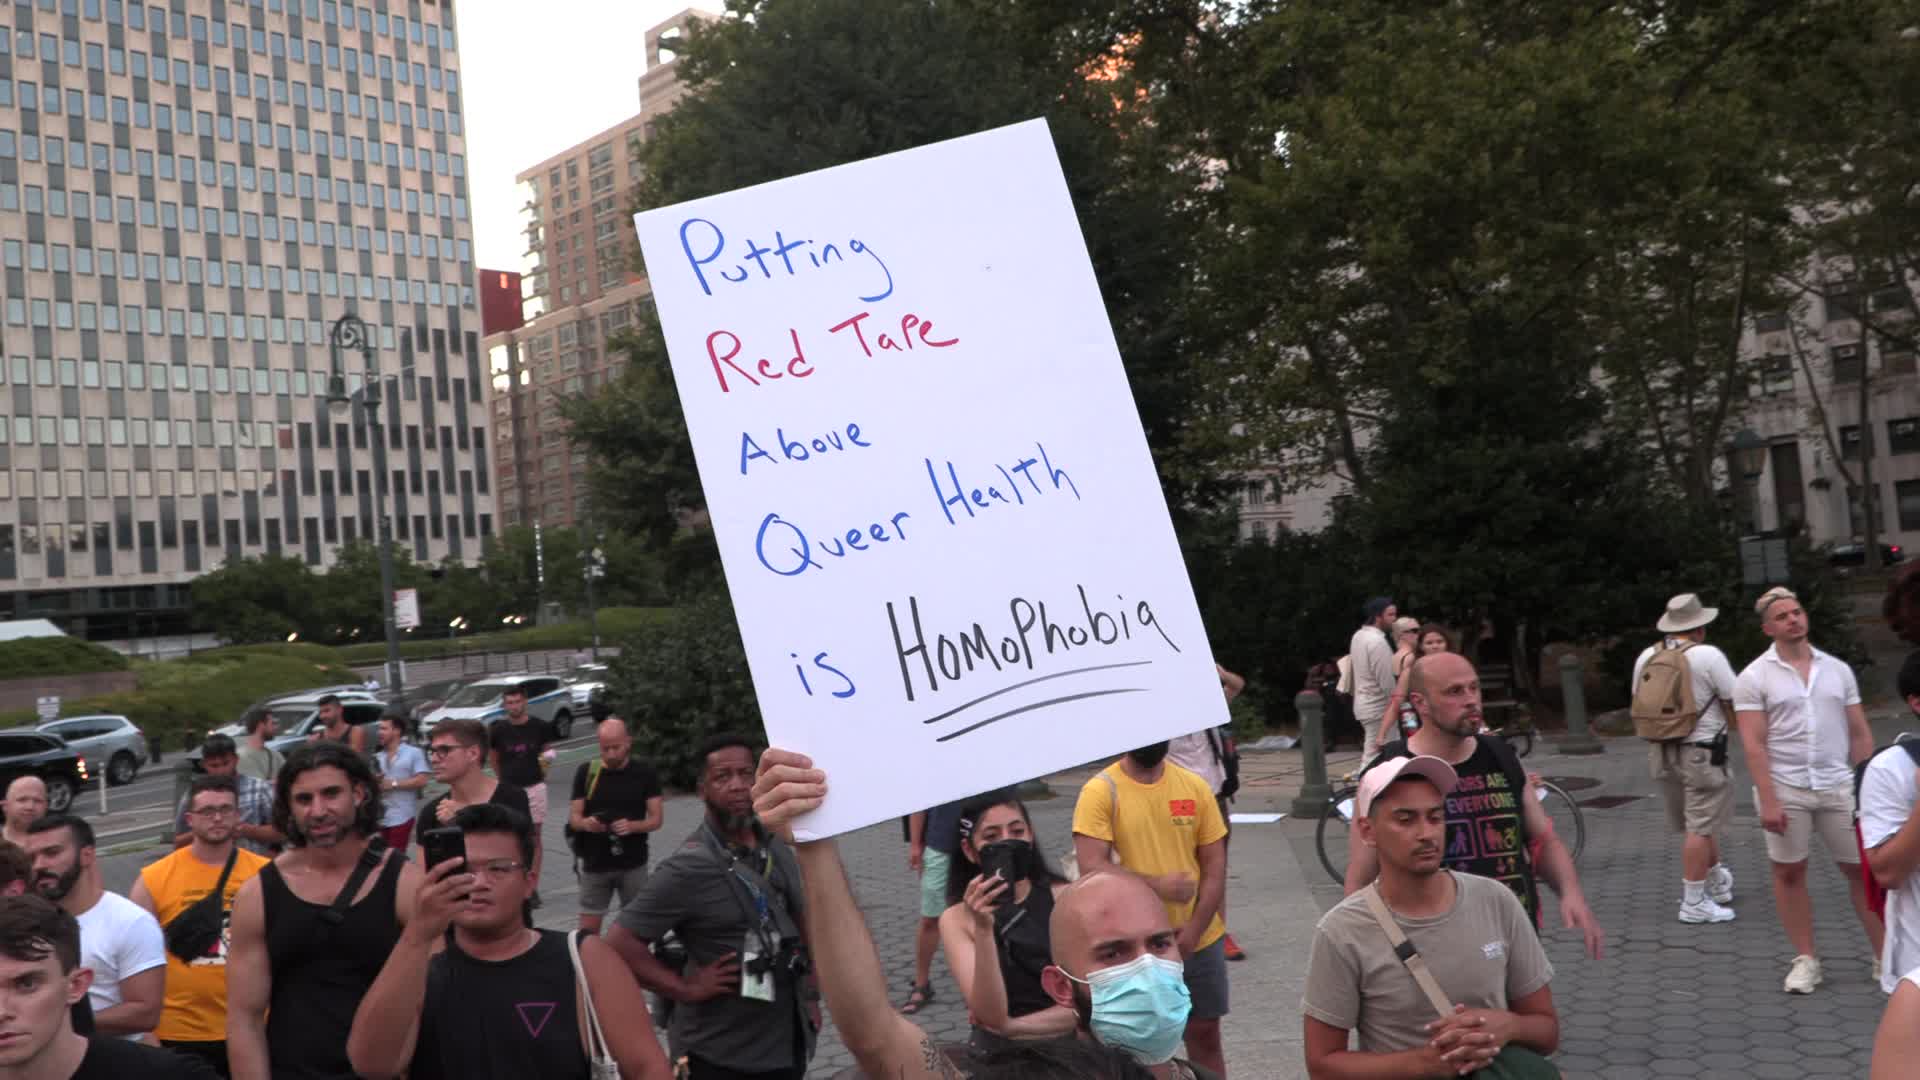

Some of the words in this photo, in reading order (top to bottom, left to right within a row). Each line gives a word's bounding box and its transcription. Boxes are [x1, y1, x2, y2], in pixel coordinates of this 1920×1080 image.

[679, 218, 893, 302] Putting
[706, 328, 814, 392] Red
[740, 423, 871, 475] Above
[755, 512, 910, 576] Queer
[790, 652, 856, 698] is
[1445, 792, 1516, 814] EVERYONE
